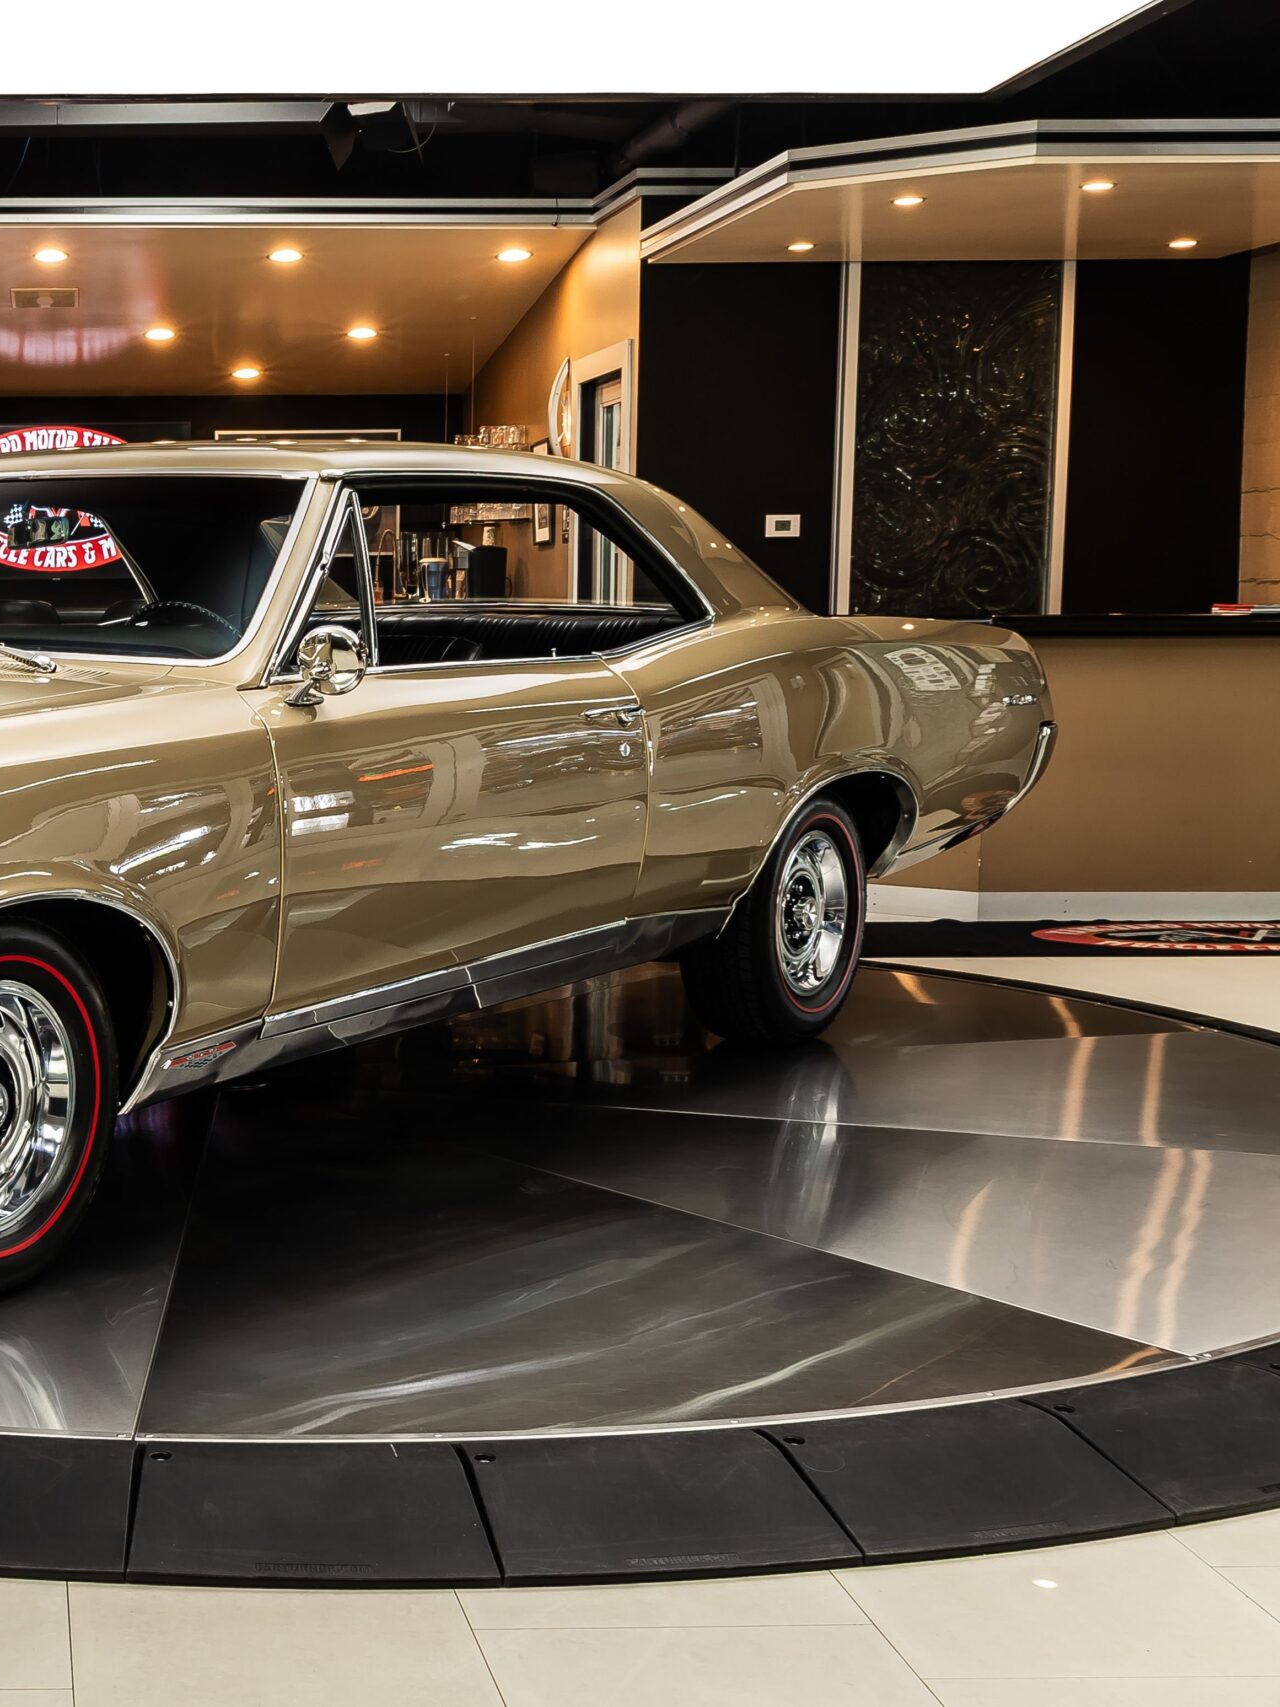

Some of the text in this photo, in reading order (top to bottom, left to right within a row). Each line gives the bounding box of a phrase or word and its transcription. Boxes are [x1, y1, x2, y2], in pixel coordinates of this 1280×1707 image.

[23, 429, 79, 450] MOTOR
[33, 546, 78, 568] CARS
[81, 542, 96, 564] &
